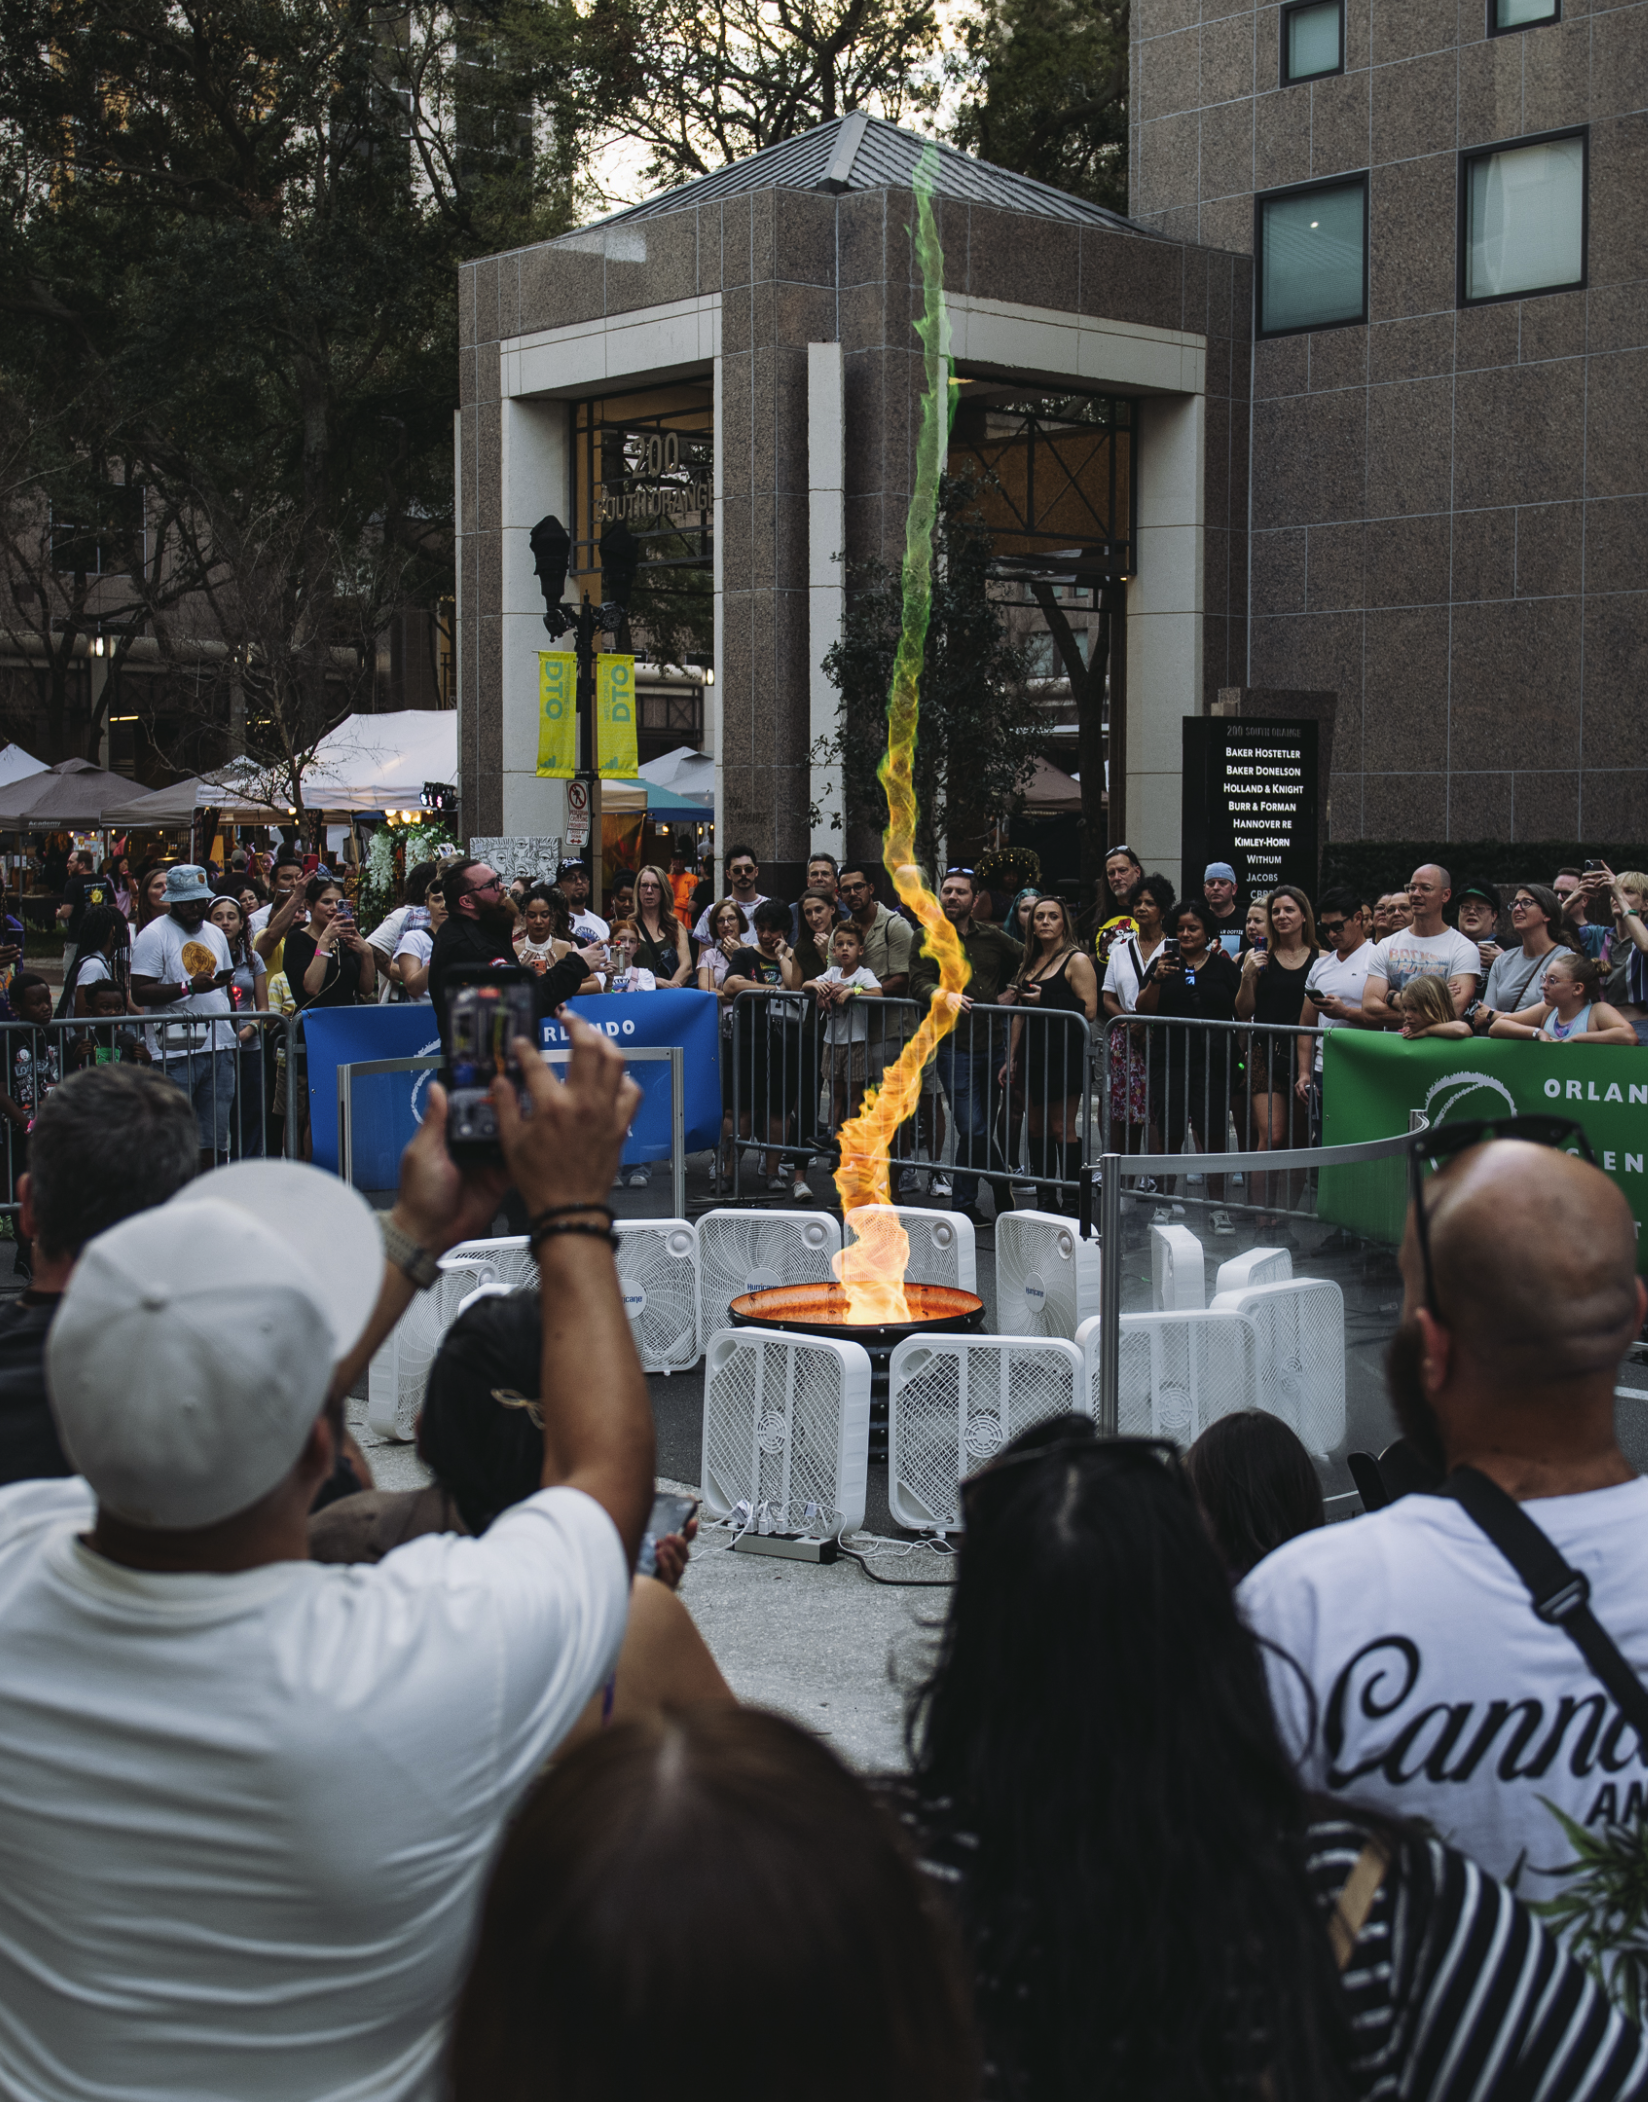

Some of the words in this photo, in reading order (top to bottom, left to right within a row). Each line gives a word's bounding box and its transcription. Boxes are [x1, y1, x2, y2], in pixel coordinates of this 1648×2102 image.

[632, 432, 679, 479] 200
[596, 491, 647, 523] SOUTH
[650, 482, 714, 516] ORANGE
[545, 661, 564, 720] DTO
[611, 664, 630, 722] DTO
[603, 679, 611, 722] WELCOME
[1227, 725, 1243, 738] 200
[1245, 727, 1270, 737] SOUTH
[1271, 727, 1302, 738] ORANGE
[1225, 746, 1254, 758] BAKER
[1254, 747, 1301, 759] HOSTETLER
[1226, 764, 1255, 776] BAKER
[1255, 765, 1301, 776] DONELSON
[1223, 782, 1264, 794] HOLLAND
[1264, 784, 1271, 794] &
[1272, 783, 1304, 795] KNIGHT
[1228, 800, 1252, 811] BURR
[1251, 801, 1259, 811] &
[1260, 801, 1297, 812] FORMAN
[28, 820, 61, 829] Academy
[1233, 818, 1281, 829] HANNOVER
[1282, 819, 1293, 830] RE
[1234, 836, 1291, 848] KIMLEY-HORN
[1246, 854, 1282, 865] WITHUM
[1246, 872, 1279, 883] JACOBS
[1250, 889, 1274, 900] CBR
